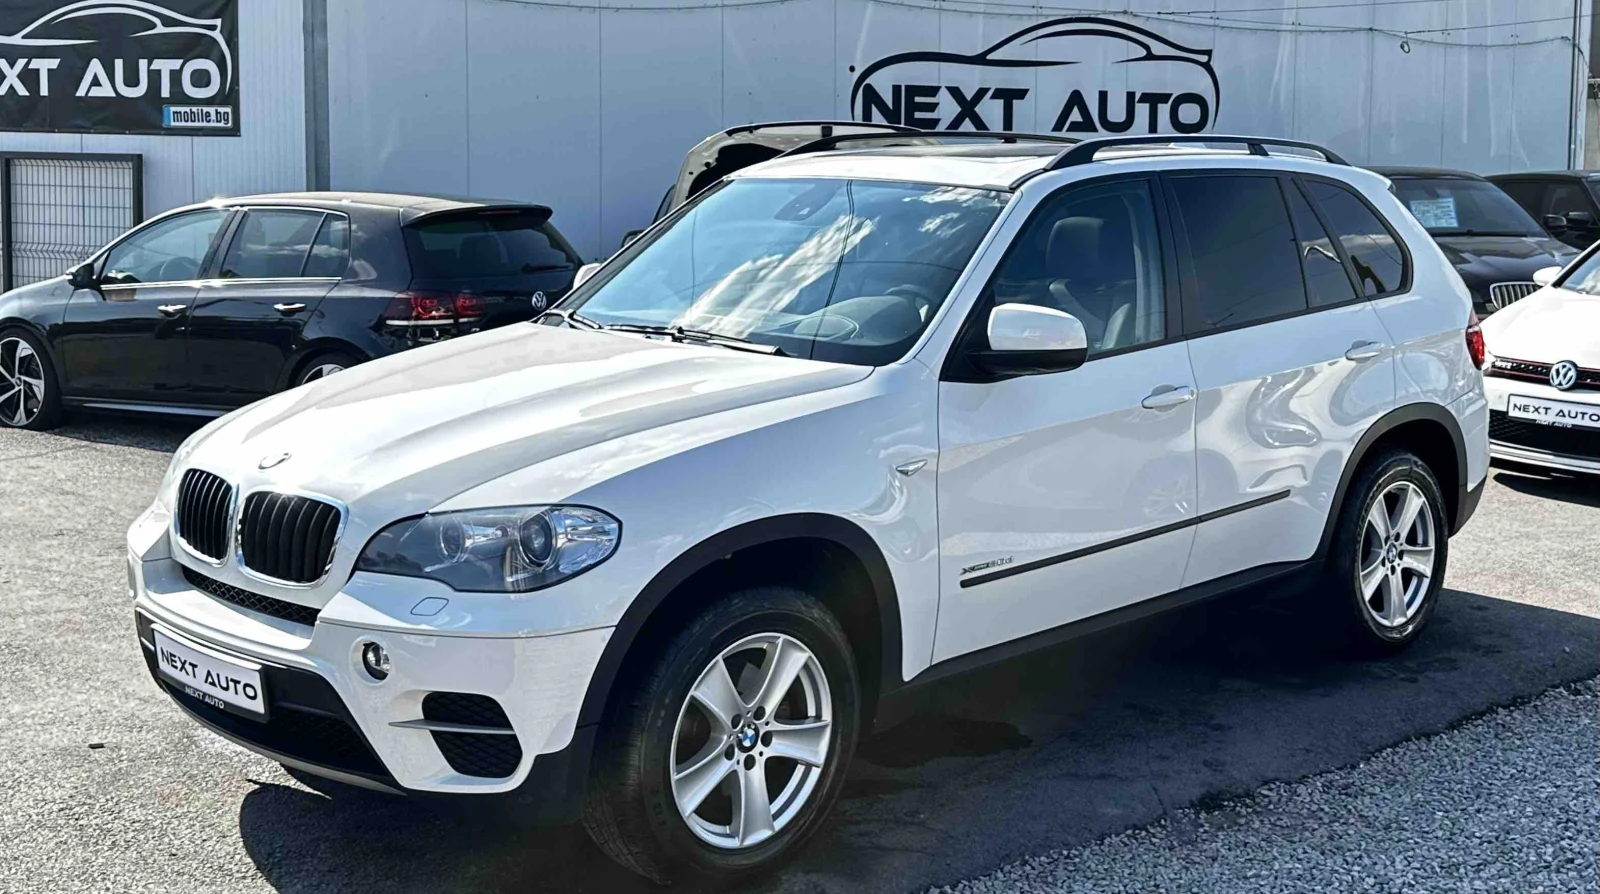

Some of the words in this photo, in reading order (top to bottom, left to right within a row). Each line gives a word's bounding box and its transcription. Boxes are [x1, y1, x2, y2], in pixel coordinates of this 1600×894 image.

[0, 57, 61, 96] XT
[75, 57, 221, 99] AUTO
[172, 108, 230, 125] mobile.bg
[862, 83, 1030, 131] NEXT
[1051, 89, 1210, 133] AUTO
[1513, 403, 1552, 415] NEXT
[1555, 409, 1600, 422] AUTO
[160, 646, 198, 679] NEXT
[204, 669, 258, 701] AUTO
[185, 685, 204, 700] NEXT
[204, 695, 225, 709] AUTO
